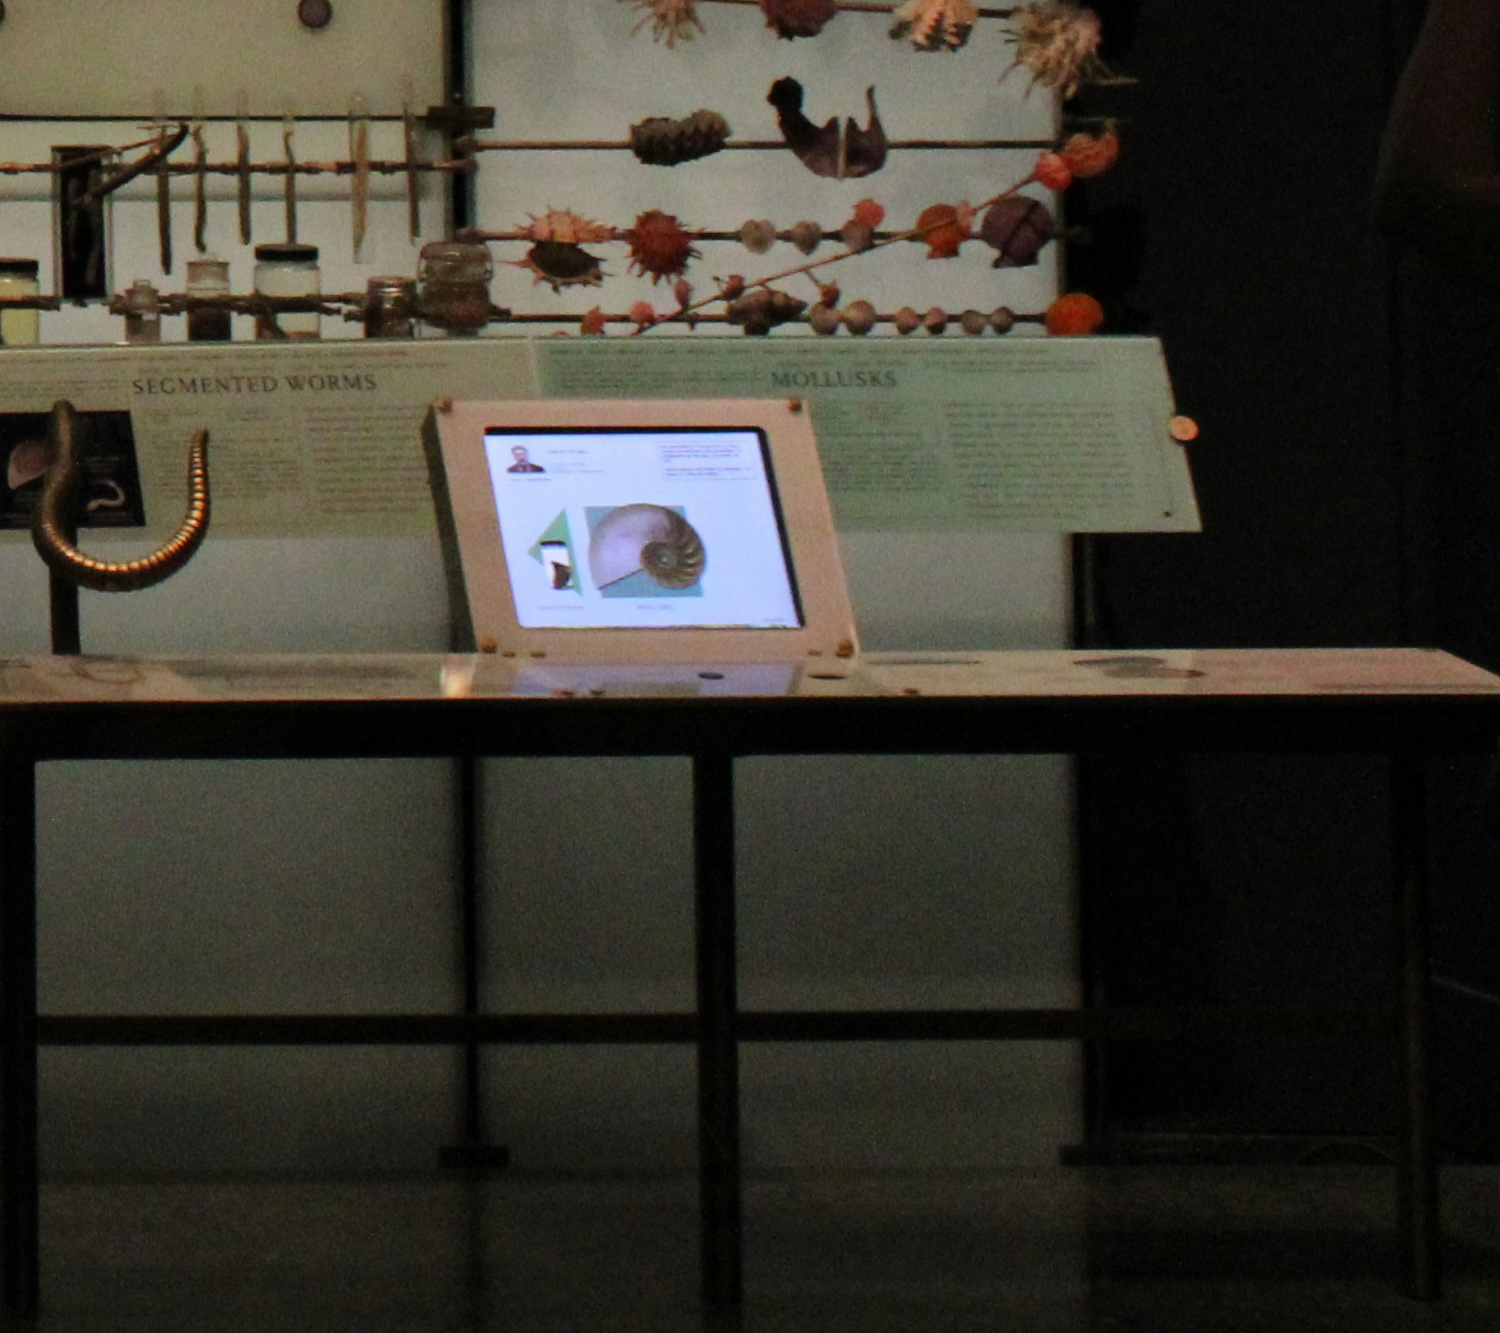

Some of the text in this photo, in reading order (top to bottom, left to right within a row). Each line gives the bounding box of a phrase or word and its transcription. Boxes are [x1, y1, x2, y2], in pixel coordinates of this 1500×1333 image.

[131, 376, 278, 395] SEGMENTED
[284, 374, 378, 393] WORMS
[770, 369, 899, 389] MOLLUSKS
